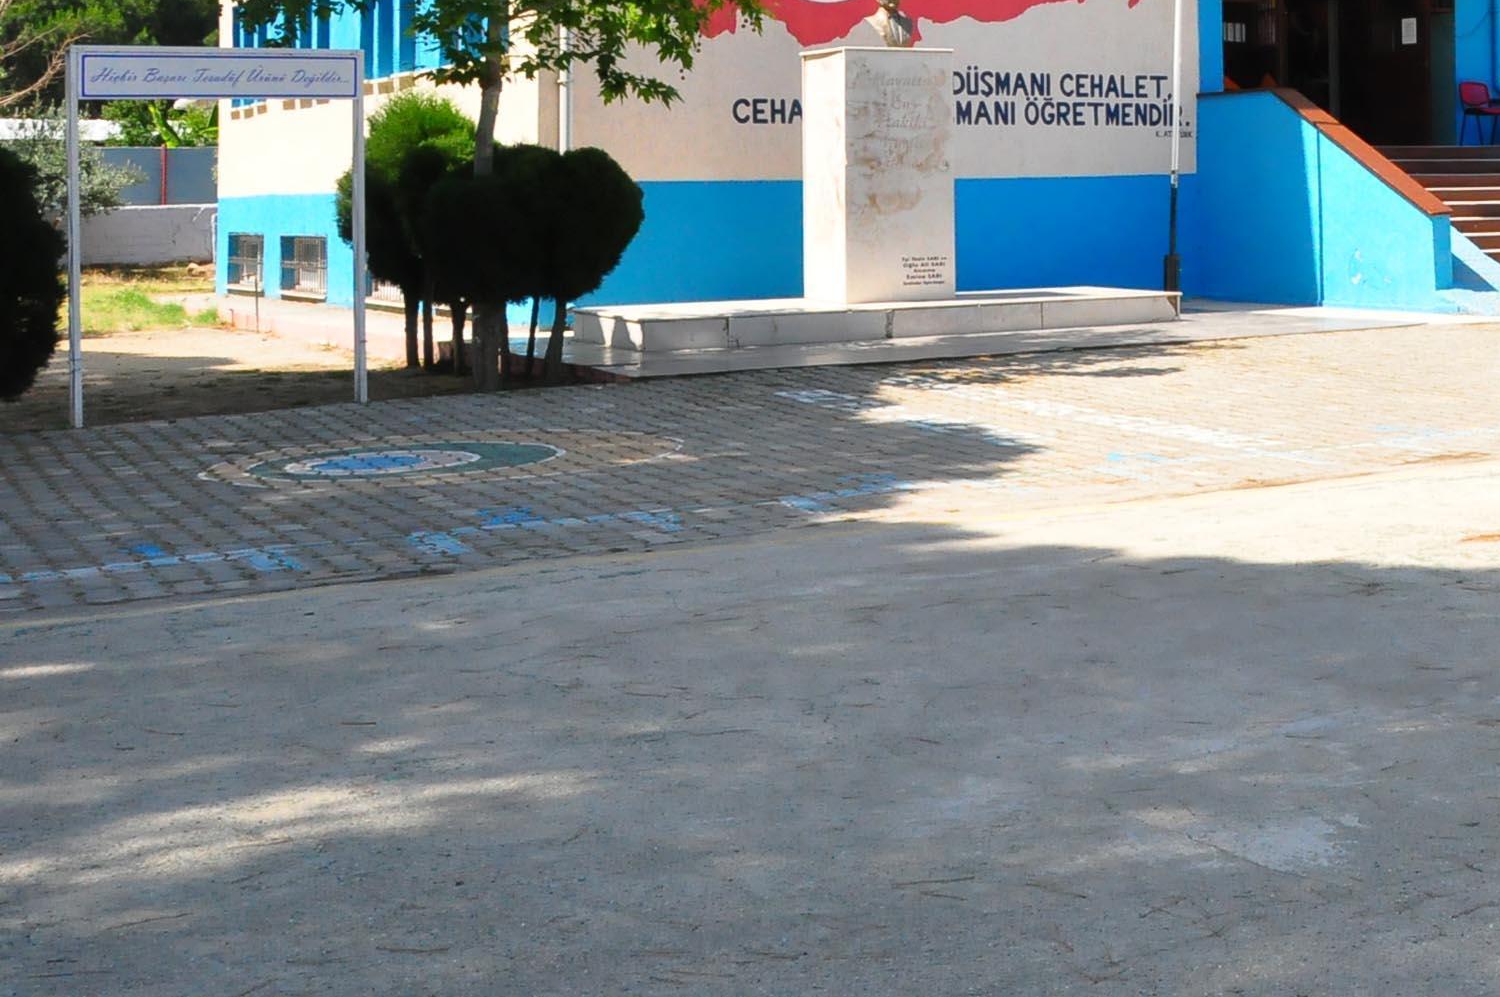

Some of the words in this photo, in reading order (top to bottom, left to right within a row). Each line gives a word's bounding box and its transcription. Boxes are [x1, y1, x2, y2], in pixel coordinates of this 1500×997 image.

[192, 67, 245, 87] Tesadüf
[953, 65, 1051, 97] DÜŞMANI
[1060, 73, 1173, 100] CEHALET,
[732, 98, 803, 124] CEHA
[953, 100, 1016, 126] MANI
